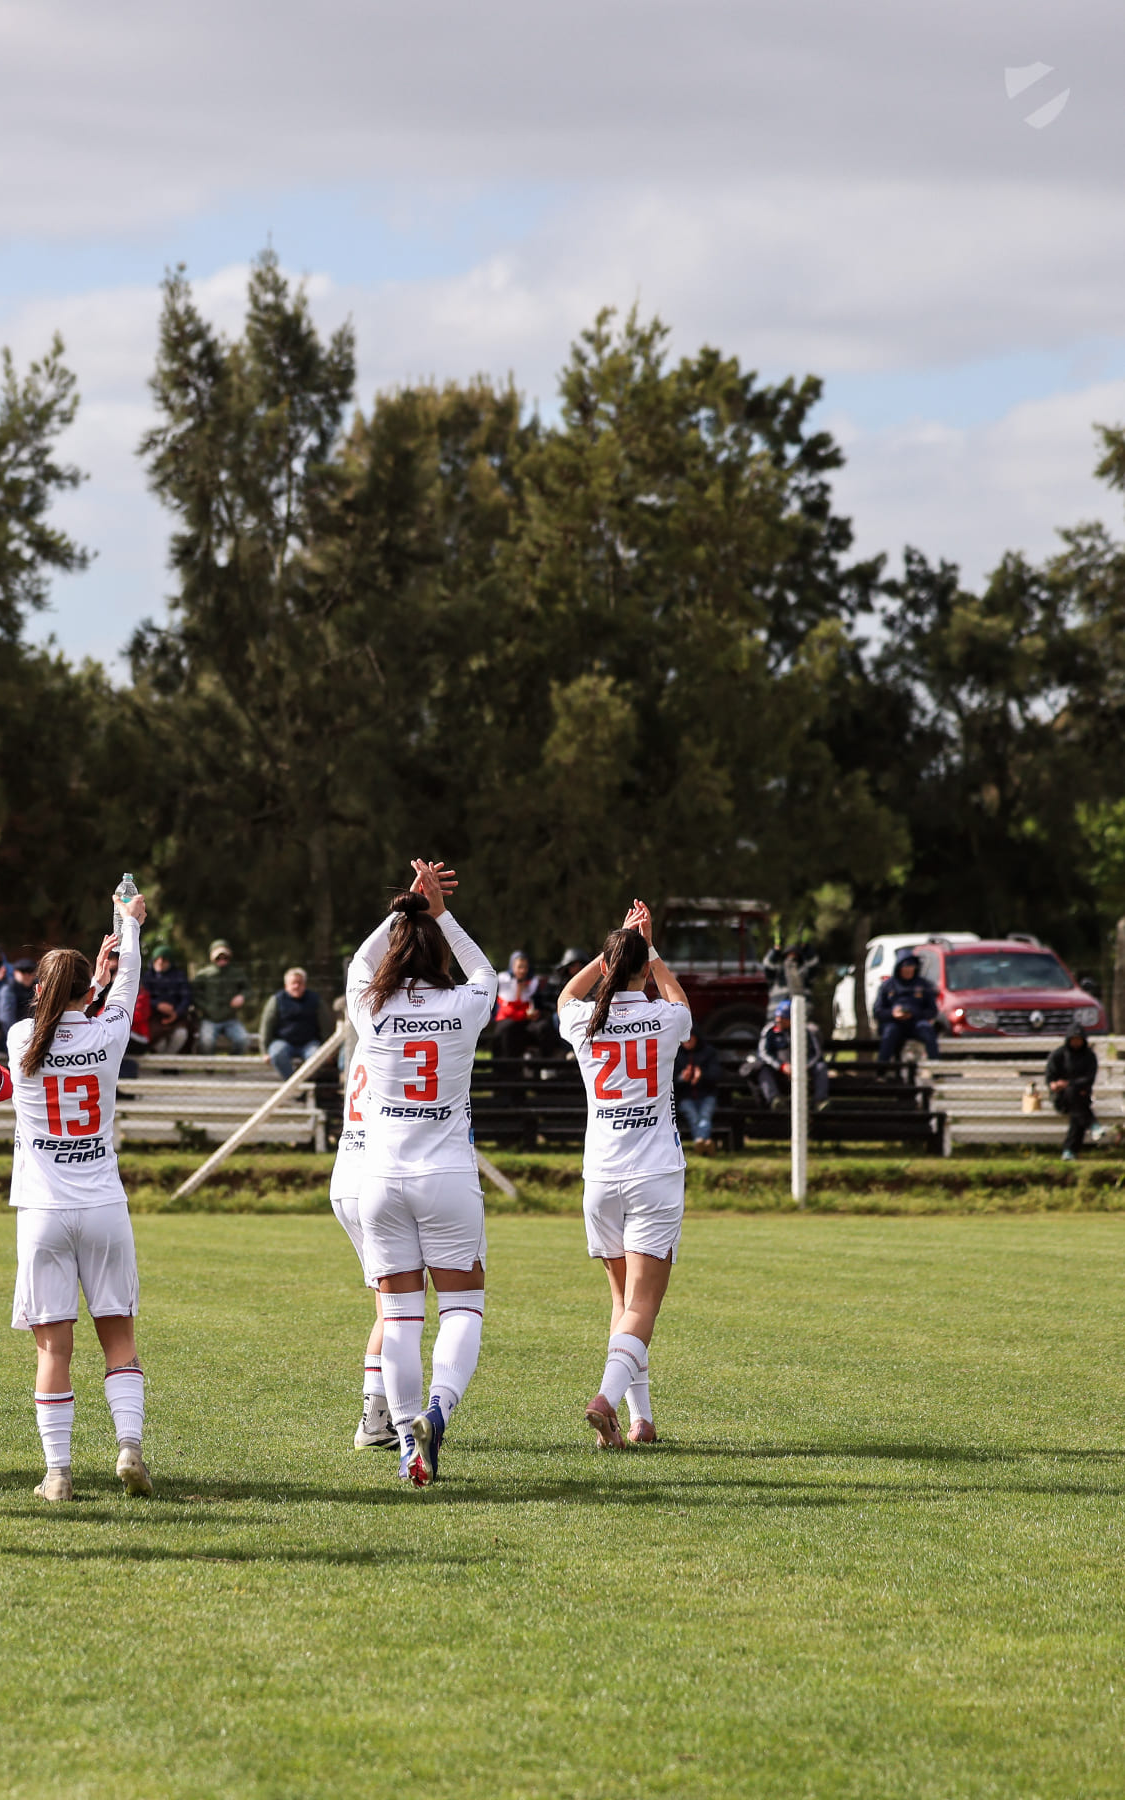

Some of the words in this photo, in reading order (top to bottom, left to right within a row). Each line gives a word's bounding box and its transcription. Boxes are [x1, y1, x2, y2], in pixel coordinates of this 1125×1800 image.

[393, 1018, 462, 1033] Rexona
[602, 1020, 661, 1034] Rexona
[42, 1050, 107, 1068] Rexona
[403, 1041, 439, 1102] 3
[592, 1039, 658, 1100] 24
[43, 1075, 101, 1136] 13
[596, 1105, 656, 1119] ASSIST
[612, 1117, 659, 1130] CARD
[32, 1138, 104, 1151] ASSIST
[54, 1146, 106, 1164] CARD
